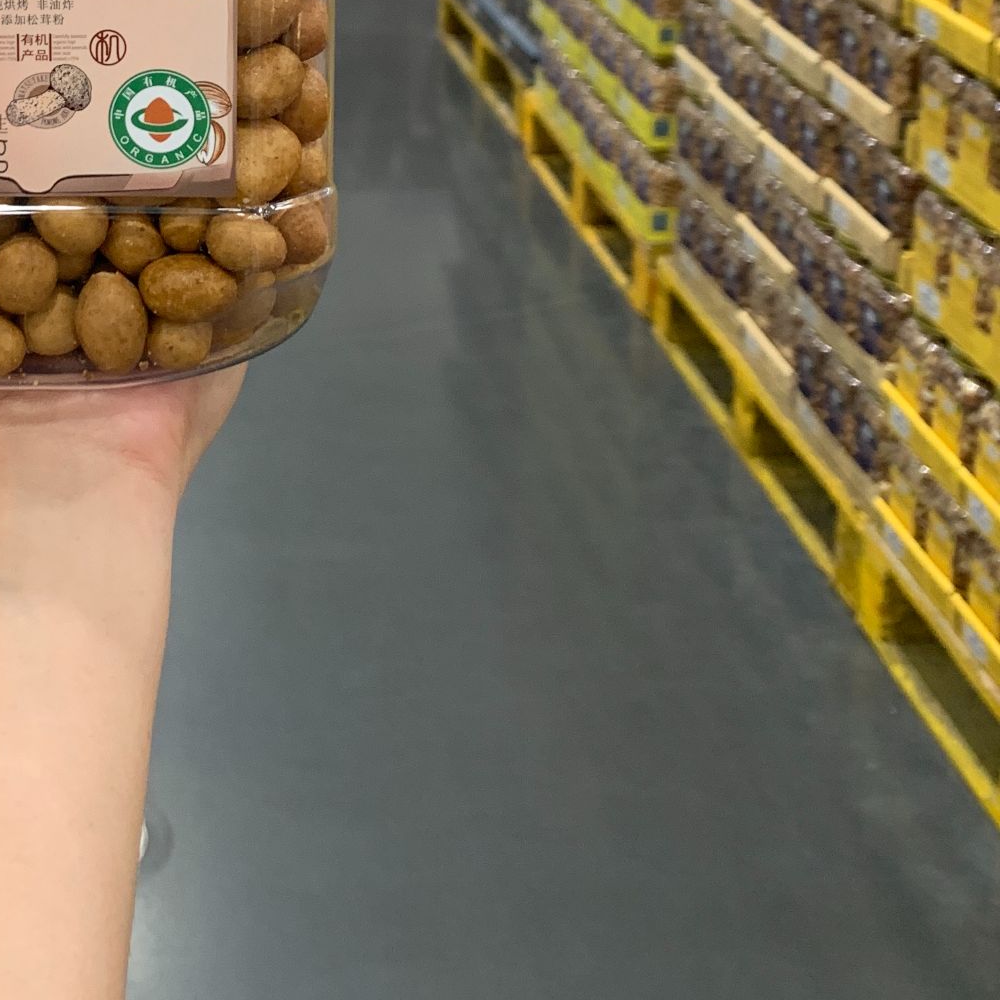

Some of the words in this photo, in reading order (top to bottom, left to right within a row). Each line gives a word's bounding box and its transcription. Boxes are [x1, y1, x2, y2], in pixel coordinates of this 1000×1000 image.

[37, 0, 74, 10] 非油炸
[1, 14, 64, 25] 添加松茸粉
[21, 34, 48, 46] 有机
[21, 49, 48, 61] 产品
[114, 76, 206, 121] 中国有机产品
[120, 134, 202, 164] ORGANIC
